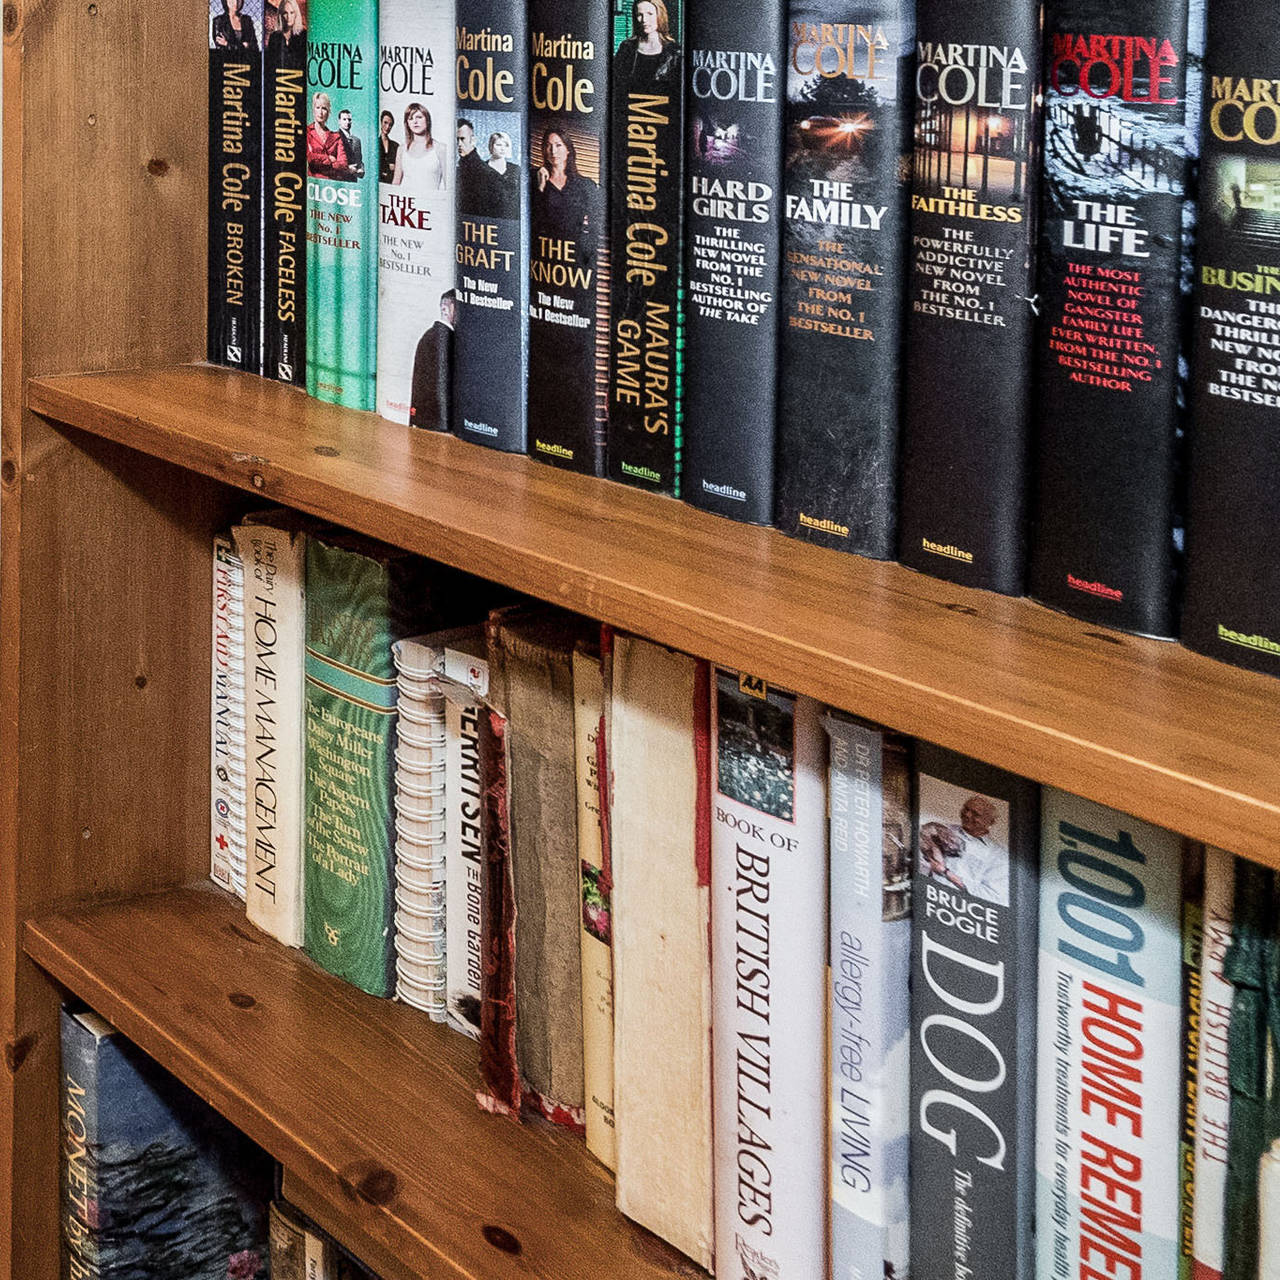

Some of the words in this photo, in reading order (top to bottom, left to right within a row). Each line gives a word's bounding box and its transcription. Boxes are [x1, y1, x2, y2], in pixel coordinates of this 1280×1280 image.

[792, 40, 888, 81] COLE
[916, 41, 1028, 74] MARTINA
[1052, 33, 1179, 67] MARTINA
[307, 58, 363, 90] COLE
[380, 61, 434, 96] COLE
[456, 55, 514, 103] Cole
[532, 62, 595, 113] Cole
[692, 67, 775, 103] COLE
[915, 63, 1027, 110] COLE
[1051, 55, 1179, 106] COLE
[626, 93, 670, 212] Martina
[388, 193, 415, 209] THE
[692, 176, 773, 202] HARD
[309, 209, 326, 221] THE
[328, 212, 353, 224] NEW
[692, 197, 770, 223] GIRLS
[786, 194, 888, 231] FAMILY
[1072, 199, 1137, 228] THE
[306, 231, 361, 250] BESTSELLER
[383, 236, 401, 247] THE
[403, 237, 424, 249] NEW
[694, 235, 766, 253] THRILLING
[714, 226, 740, 239] THE
[817, 239, 844, 254] THE
[1062, 219, 1150, 258] LIFE
[379, 259, 431, 277] BESTSELLER
[626, 222, 669, 287] Cole
[693, 246, 719, 259] NEW
[721, 251, 767, 266] NOVEL
[695, 259, 732, 273] FROM
[735, 265, 764, 277] THE
[462, 276, 476, 289] The
[477, 279, 498, 294] New
[530, 262, 592, 291] KNOW
[537, 291, 551, 306] The
[552, 295, 574, 310] New
[691, 294, 744, 311] AUTHOR
[746, 301, 768, 314] OF
[698, 306, 722, 320] THE
[726, 311, 760, 325] TAKE
[1062, 315, 1110, 332] FAMILY
[1115, 324, 1144, 339] LIFE
[616, 320, 641, 407] GAME
[644, 300, 670, 436] MAURA'S
[1048, 339, 1088, 355] FROM
[1090, 347, 1122, 364] THE
[1123, 353, 1153, 368] NO.
[463, 418, 499, 437] headline
[536, 439, 574, 460] headline
[621, 461, 661, 483] headline
[702, 479, 747, 502] headline
[264, 539, 275, 558] The
[264, 559, 275, 595] Dairy
[254, 595, 277, 691] HOME
[307, 717, 334, 741] Daisy
[336, 733, 374, 760] Miller
[321, 706, 384, 744] Europeans
[308, 767, 326, 788] The
[327, 780, 370, 810] Aspern
[318, 757, 356, 785] Square
[254, 690, 278, 904] MANAGEMENT
[311, 801, 331, 824] The
[334, 812, 361, 840] Turn
[715, 806, 765, 842] BOOK
[307, 831, 325, 852] The
[326, 842, 368, 876] Portrait
[769, 831, 800, 853] OF
[926, 884, 999, 924] BRUCE
[1057, 820, 1146, 988] 1,001
[735, 842, 770, 1026] BRITISH
[925, 903, 999, 945] FOGLE
[1053, 971, 1073, 1060] Trustworthy
[920, 929, 1007, 1171] DOG
[1055, 1061, 1072, 1136] treatments
[66, 1072, 87, 1225] MONET
[736, 1031, 773, 1237] VILLAGES
[1056, 1138, 1072, 1158] for
[1052, 1160, 1071, 1224] everyday
[67, 1214, 91, 1256] by
